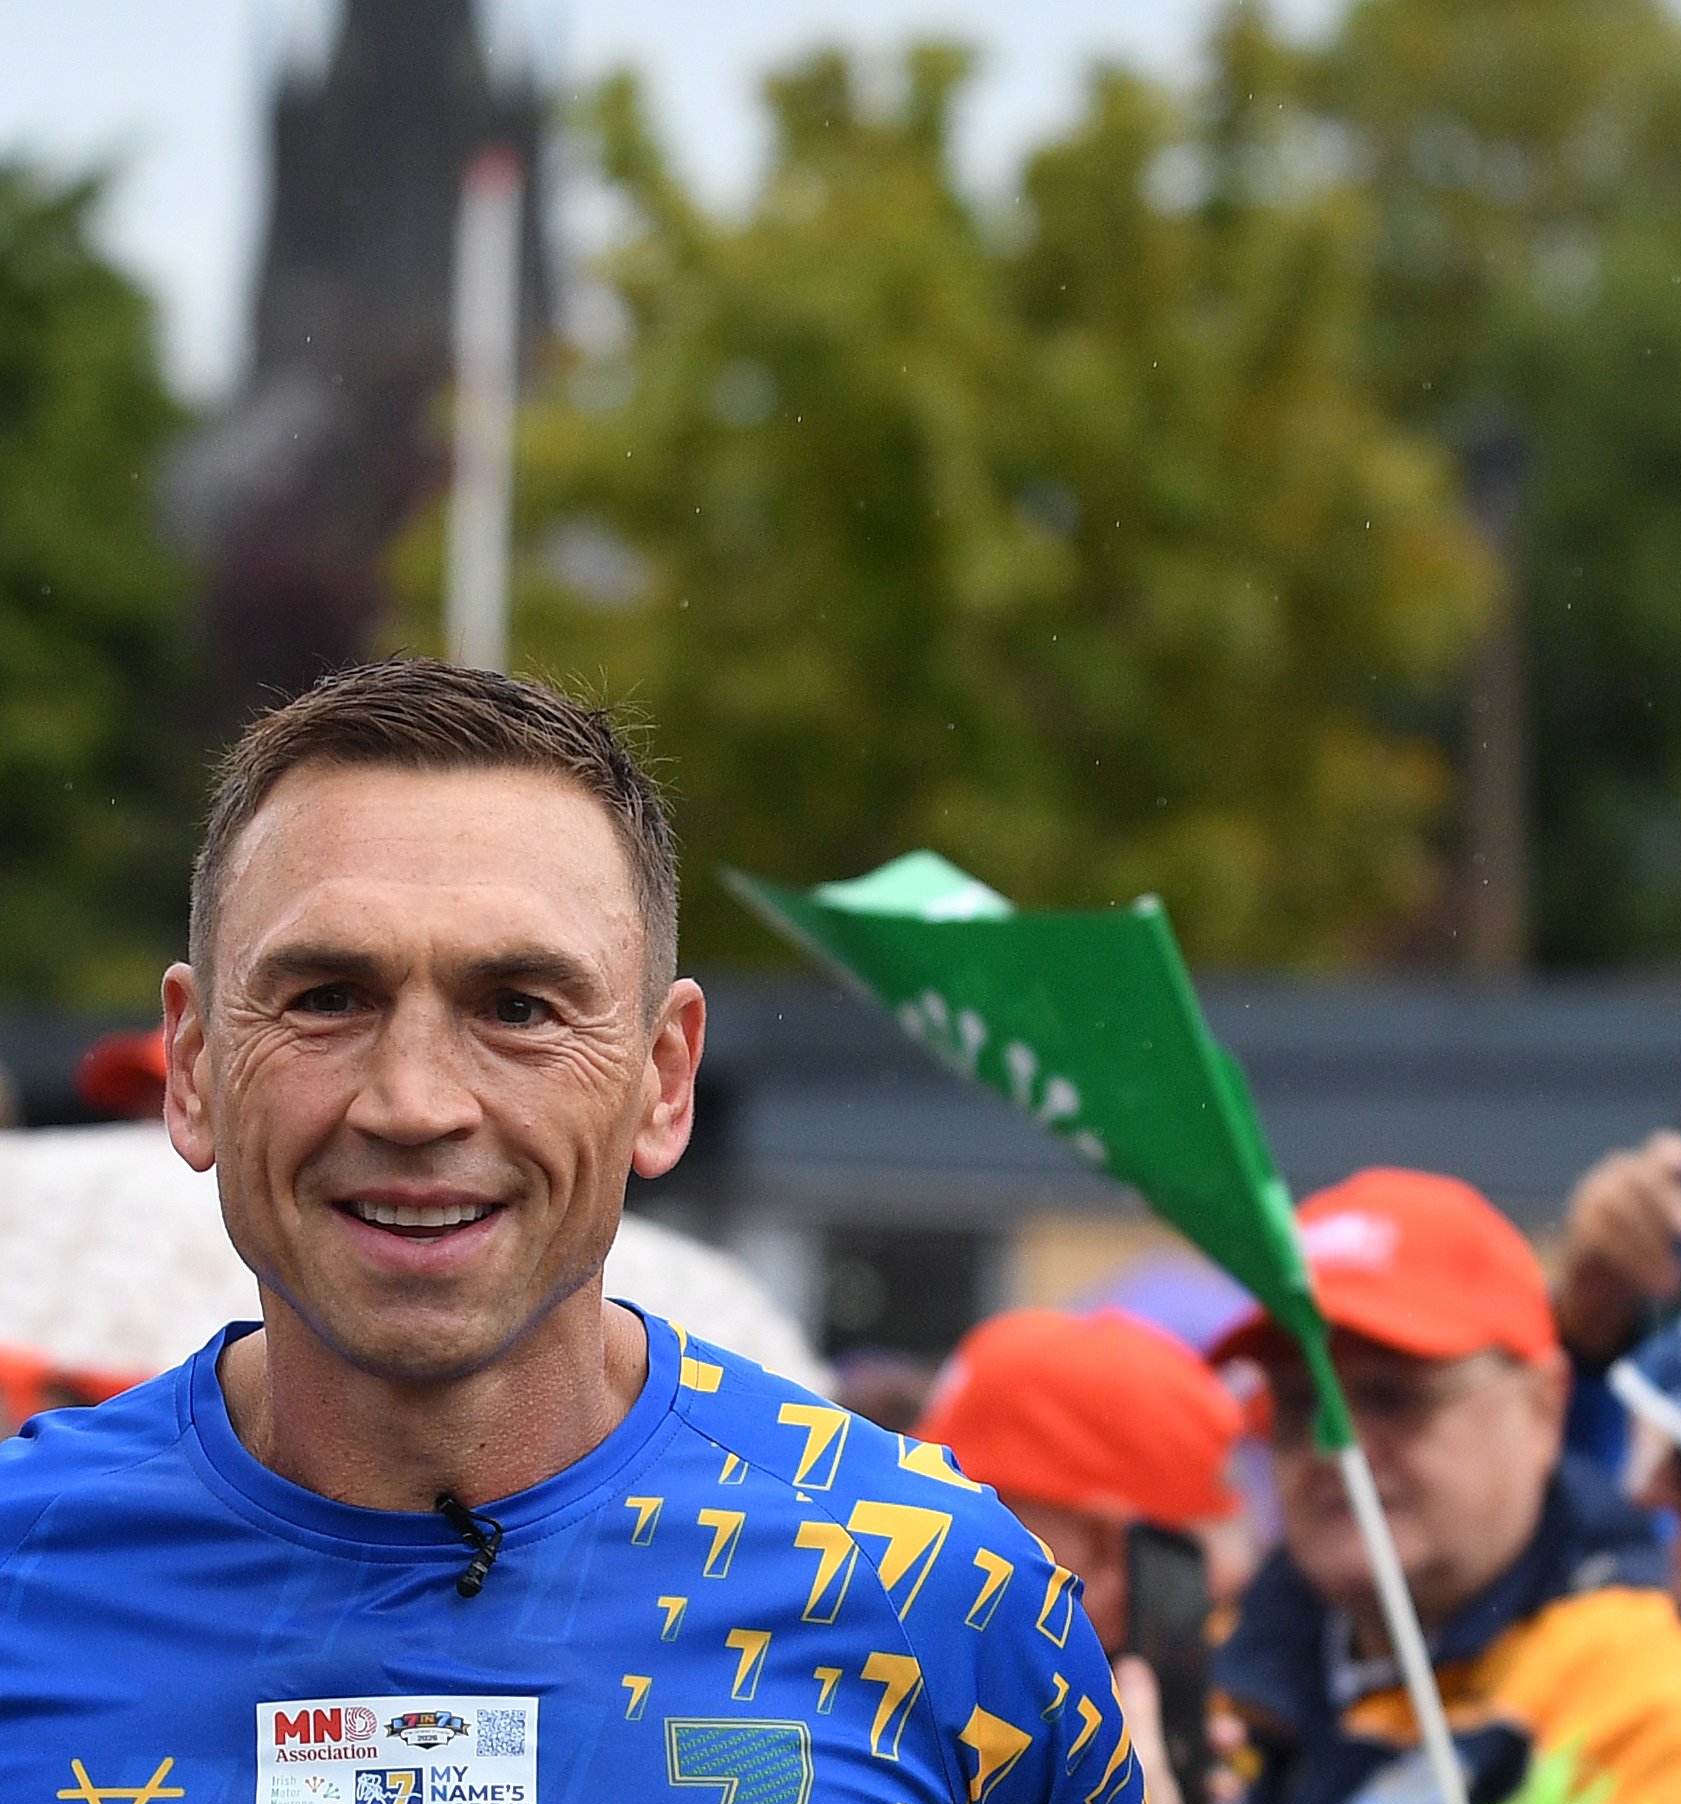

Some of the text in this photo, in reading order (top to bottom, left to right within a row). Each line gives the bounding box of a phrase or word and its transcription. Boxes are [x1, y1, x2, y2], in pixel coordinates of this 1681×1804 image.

[275, 1707, 377, 1745] MND
[276, 1744, 378, 1762] Association
[272, 1776, 297, 1786] Irish
[431, 1766, 469, 1783] MY
[271, 1788, 301, 1797] Motor
